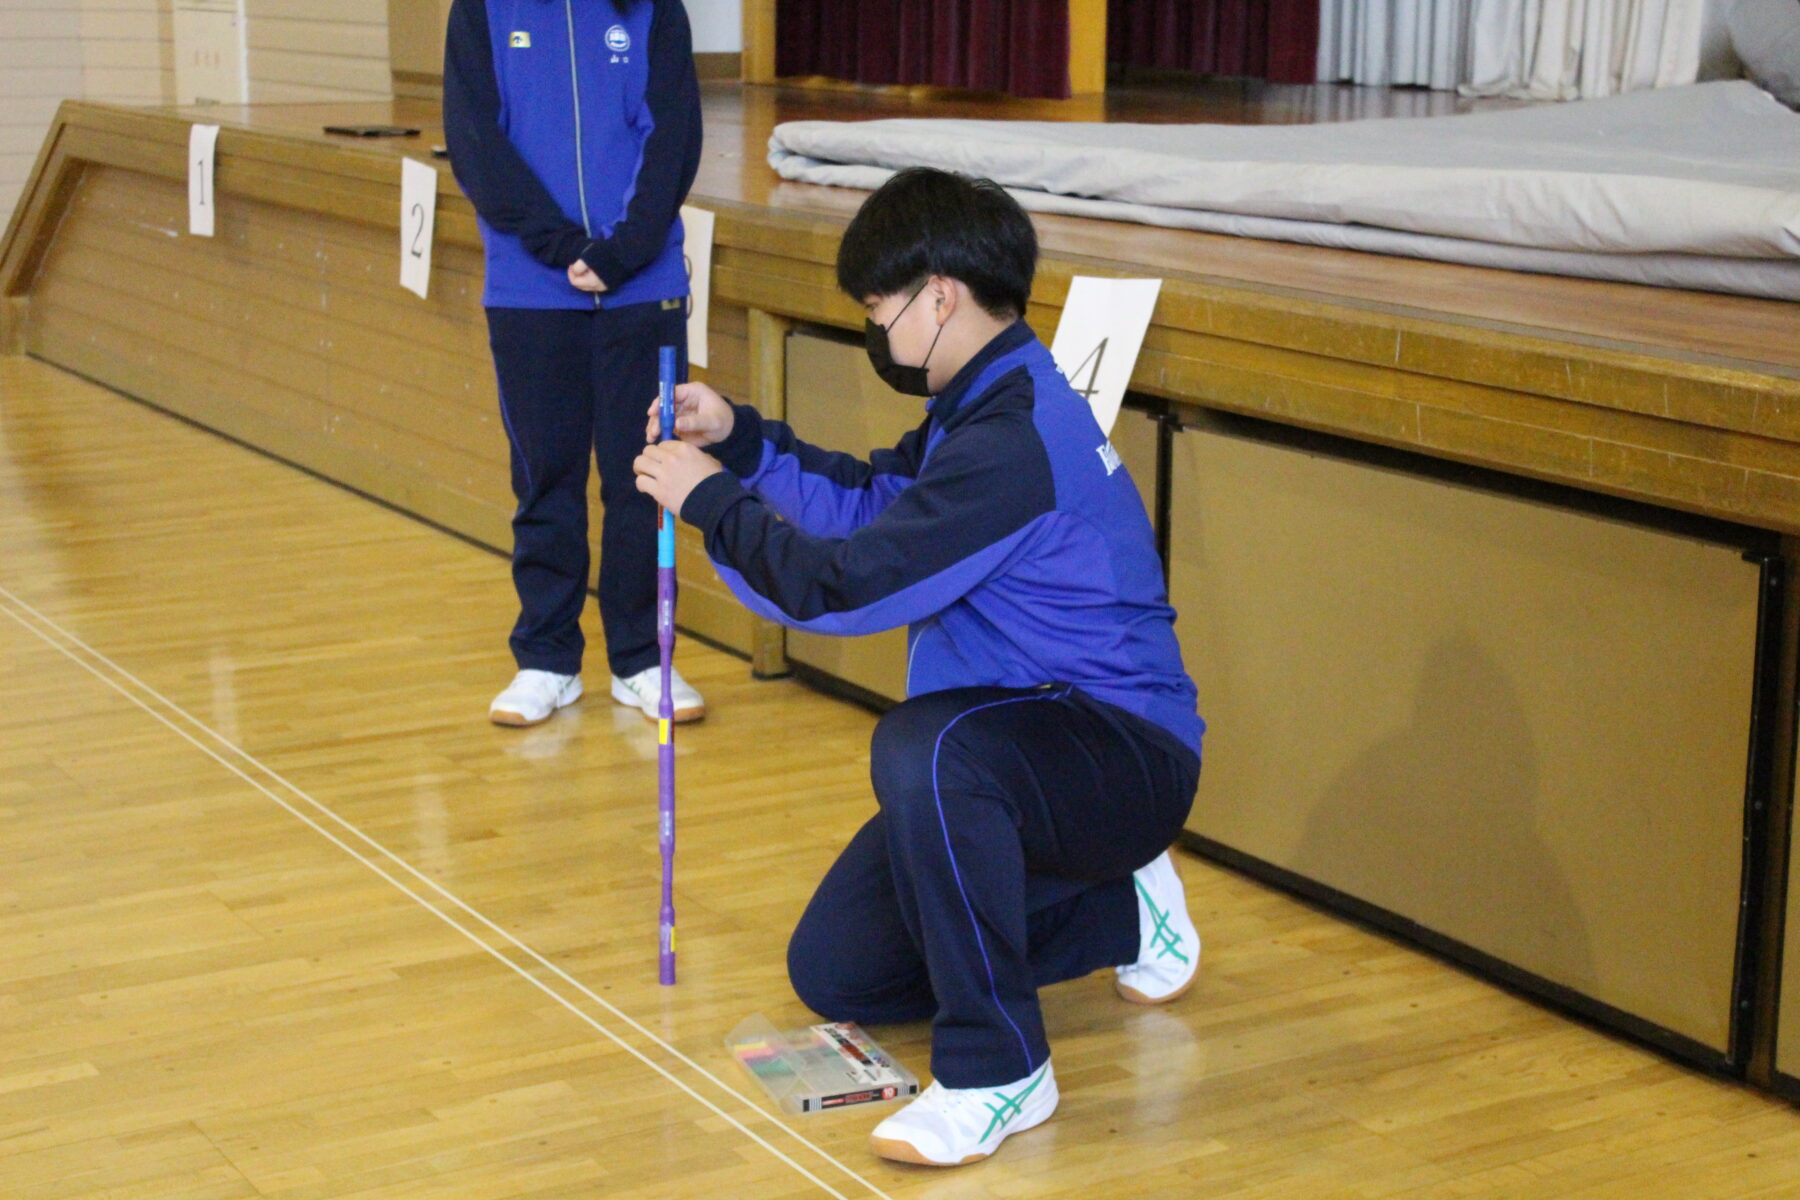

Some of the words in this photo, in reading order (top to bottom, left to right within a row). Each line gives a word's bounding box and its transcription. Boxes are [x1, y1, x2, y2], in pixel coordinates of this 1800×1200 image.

[198, 158, 205, 206] 1
[411, 202, 425, 259] 2
[1069, 337, 1109, 400] 4
